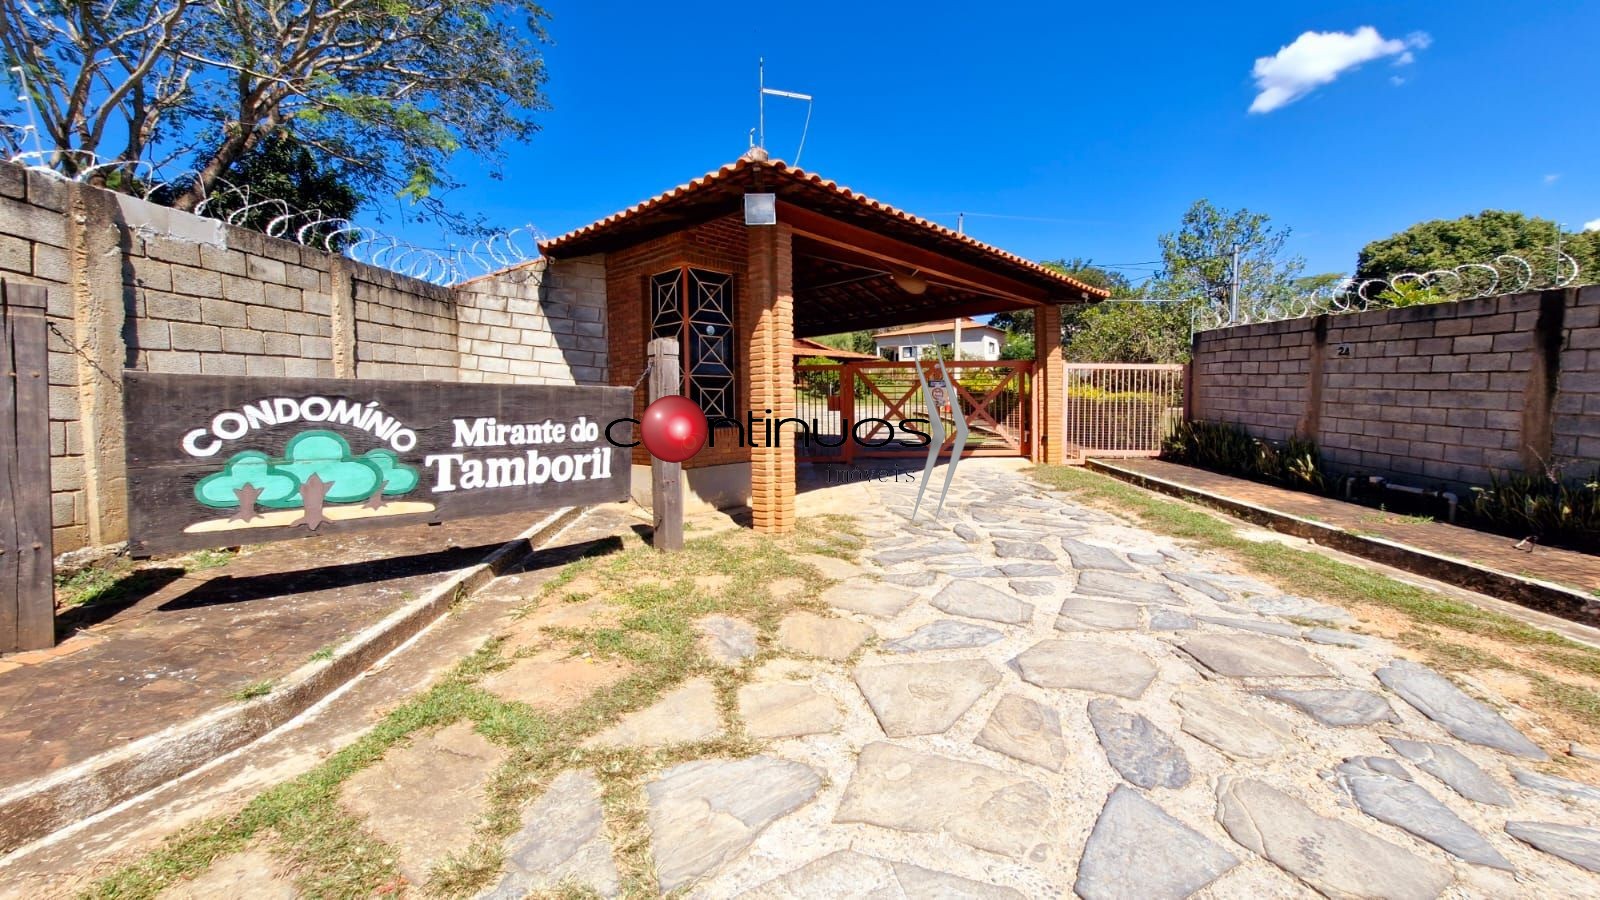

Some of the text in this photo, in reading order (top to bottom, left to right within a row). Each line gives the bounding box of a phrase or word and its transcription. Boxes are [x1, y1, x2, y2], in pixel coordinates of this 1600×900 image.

[182, 396, 417, 457] CONDOMÍNIO
[452, 416, 599, 447] Mirante do
[425, 447, 612, 493] Tamboril
